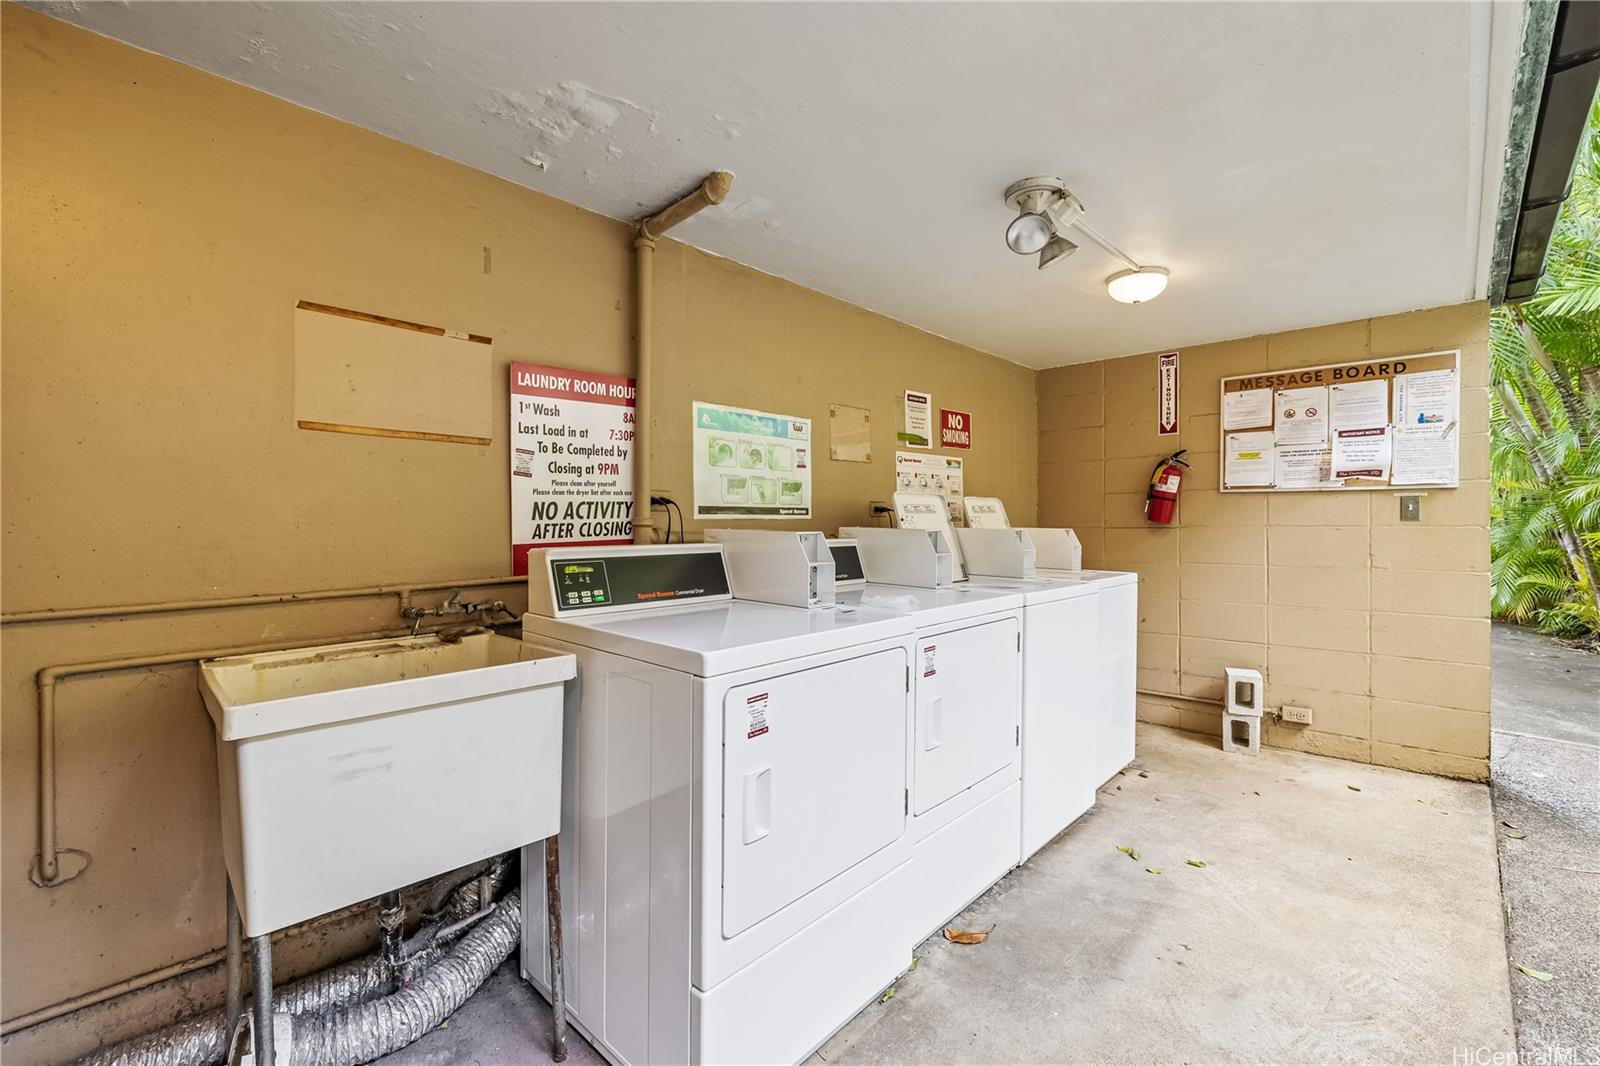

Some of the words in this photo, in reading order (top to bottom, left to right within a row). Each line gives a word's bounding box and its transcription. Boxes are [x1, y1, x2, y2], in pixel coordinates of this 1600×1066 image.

[1161, 358, 1176, 368] FIRE
[517, 371, 571, 391] LAUNDRY
[574, 379, 606, 396] ROOM
[1239, 370, 1323, 390] MESSAGE
[1333, 362, 1407, 380] BOARD
[519, 401, 531, 414] 1st
[533, 402, 560, 417] Wash
[623, 412, 635, 424] 8A
[948, 413, 963, 430] NO
[518, 421, 539, 435] Last
[543, 423, 565, 437] Load
[568, 426, 577, 438] in
[579, 428, 589, 438] at
[609, 429, 635, 441] 7:30P
[942, 428, 969, 445] SMOKING
[537, 441, 548, 454] To
[552, 442, 564, 454] Be
[567, 443, 615, 459] Completed
[617, 445, 628, 460] by
[548, 461, 582, 478] Closing
[585, 465, 595, 475] at
[597, 463, 620, 475] 9PM
[551, 479, 568, 487] Please
[597, 480, 617, 488] yourself
[532, 488, 550, 496] Please
[551, 488, 565, 496] clean
[566, 488, 575, 496] the
[576, 488, 590, 497] dryer
[531, 501, 559, 521] NO
[563, 500, 634, 520] ACTIVITY
[532, 522, 575, 539] AFTER
[579, 521, 633, 538] CLOSING
